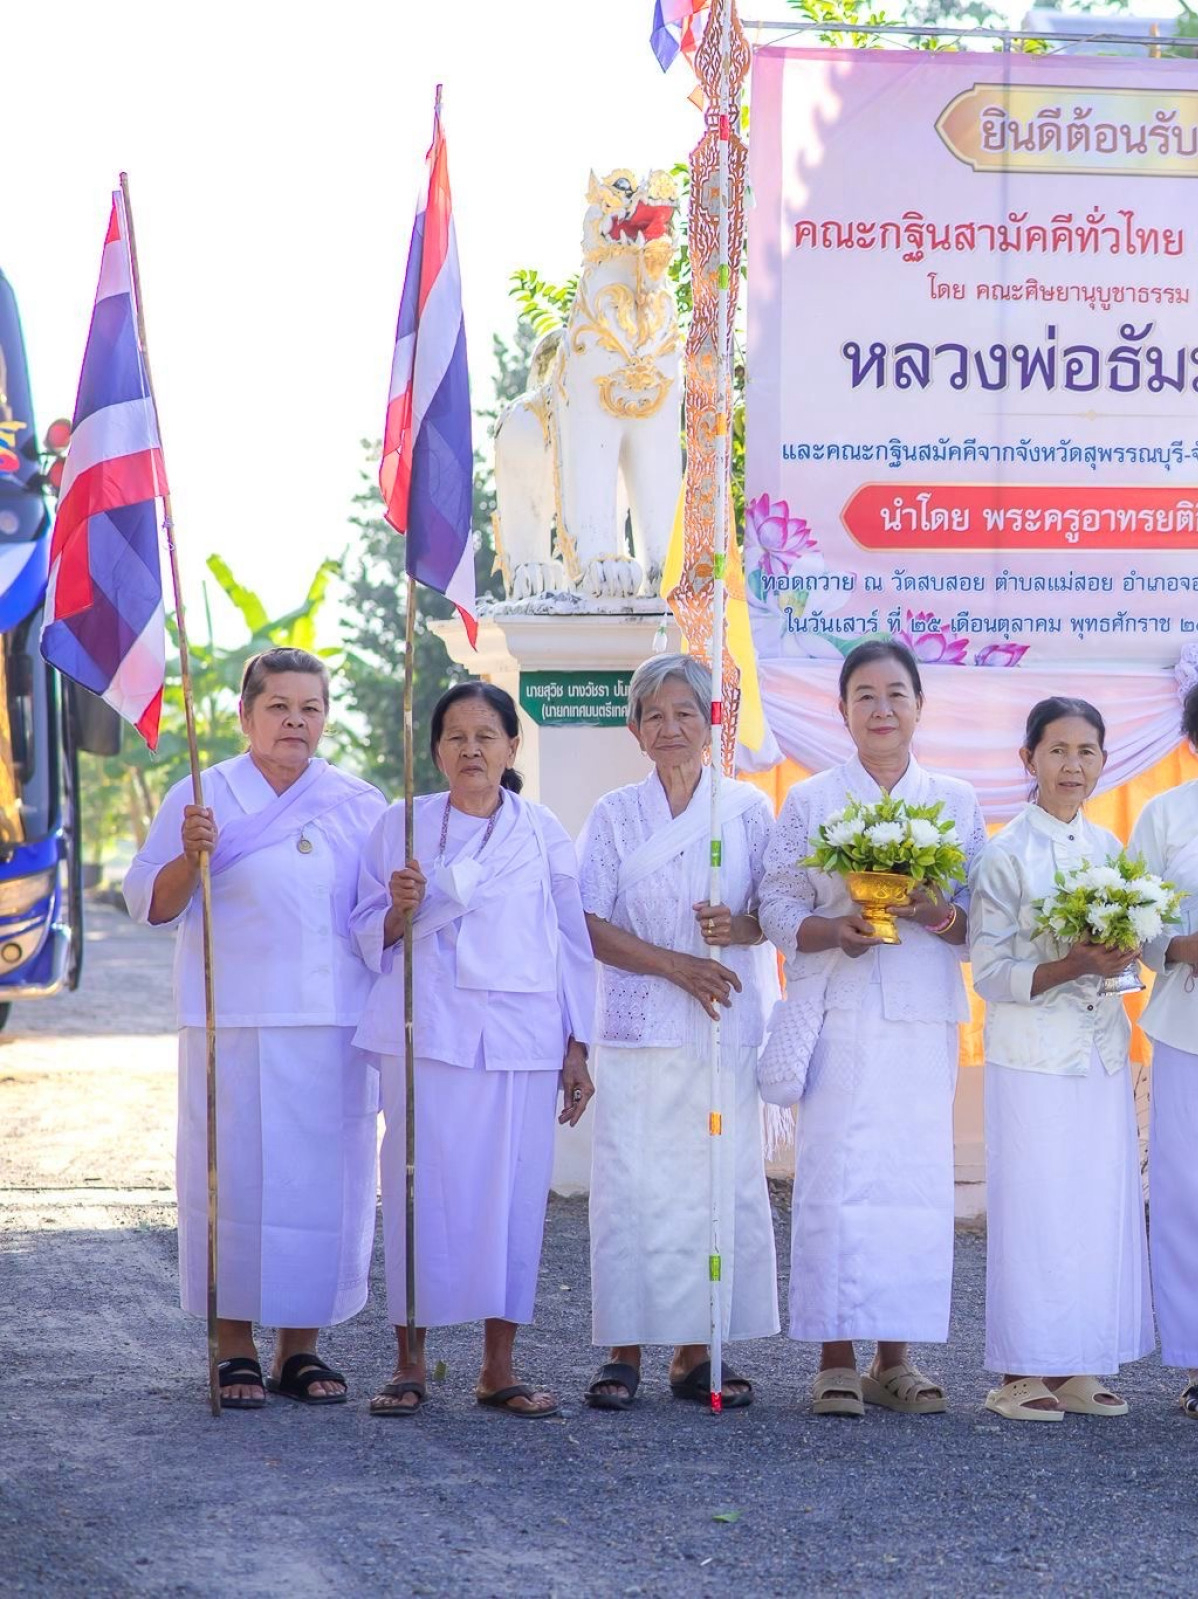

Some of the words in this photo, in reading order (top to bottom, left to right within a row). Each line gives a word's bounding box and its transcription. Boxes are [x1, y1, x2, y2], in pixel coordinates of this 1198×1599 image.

[982, 107, 1198, 156] ยินดีต้อนรับ
[794, 206, 1185, 263] คณะกฐินสามัคคีทั่วไทย
[926, 271, 966, 301] โดย
[976, 277, 1190, 311] คณะศิษยานุบูชาธรรม
[879, 492, 970, 532] นำโดย
[761, 571, 855, 592] ทอดถวาย
[864, 575, 884, 592] ณ
[891, 568, 985, 592] วัดสบสอย
[995, 568, 1113, 592] ตำบลแม่สอย
[783, 606, 879, 633] ในวันเสาร์
[886, 606, 902, 633] ที่
[950, 611, 1062, 640] เดือนตุลาคม
[1070, 611, 1172, 640] พุทธศักราช
